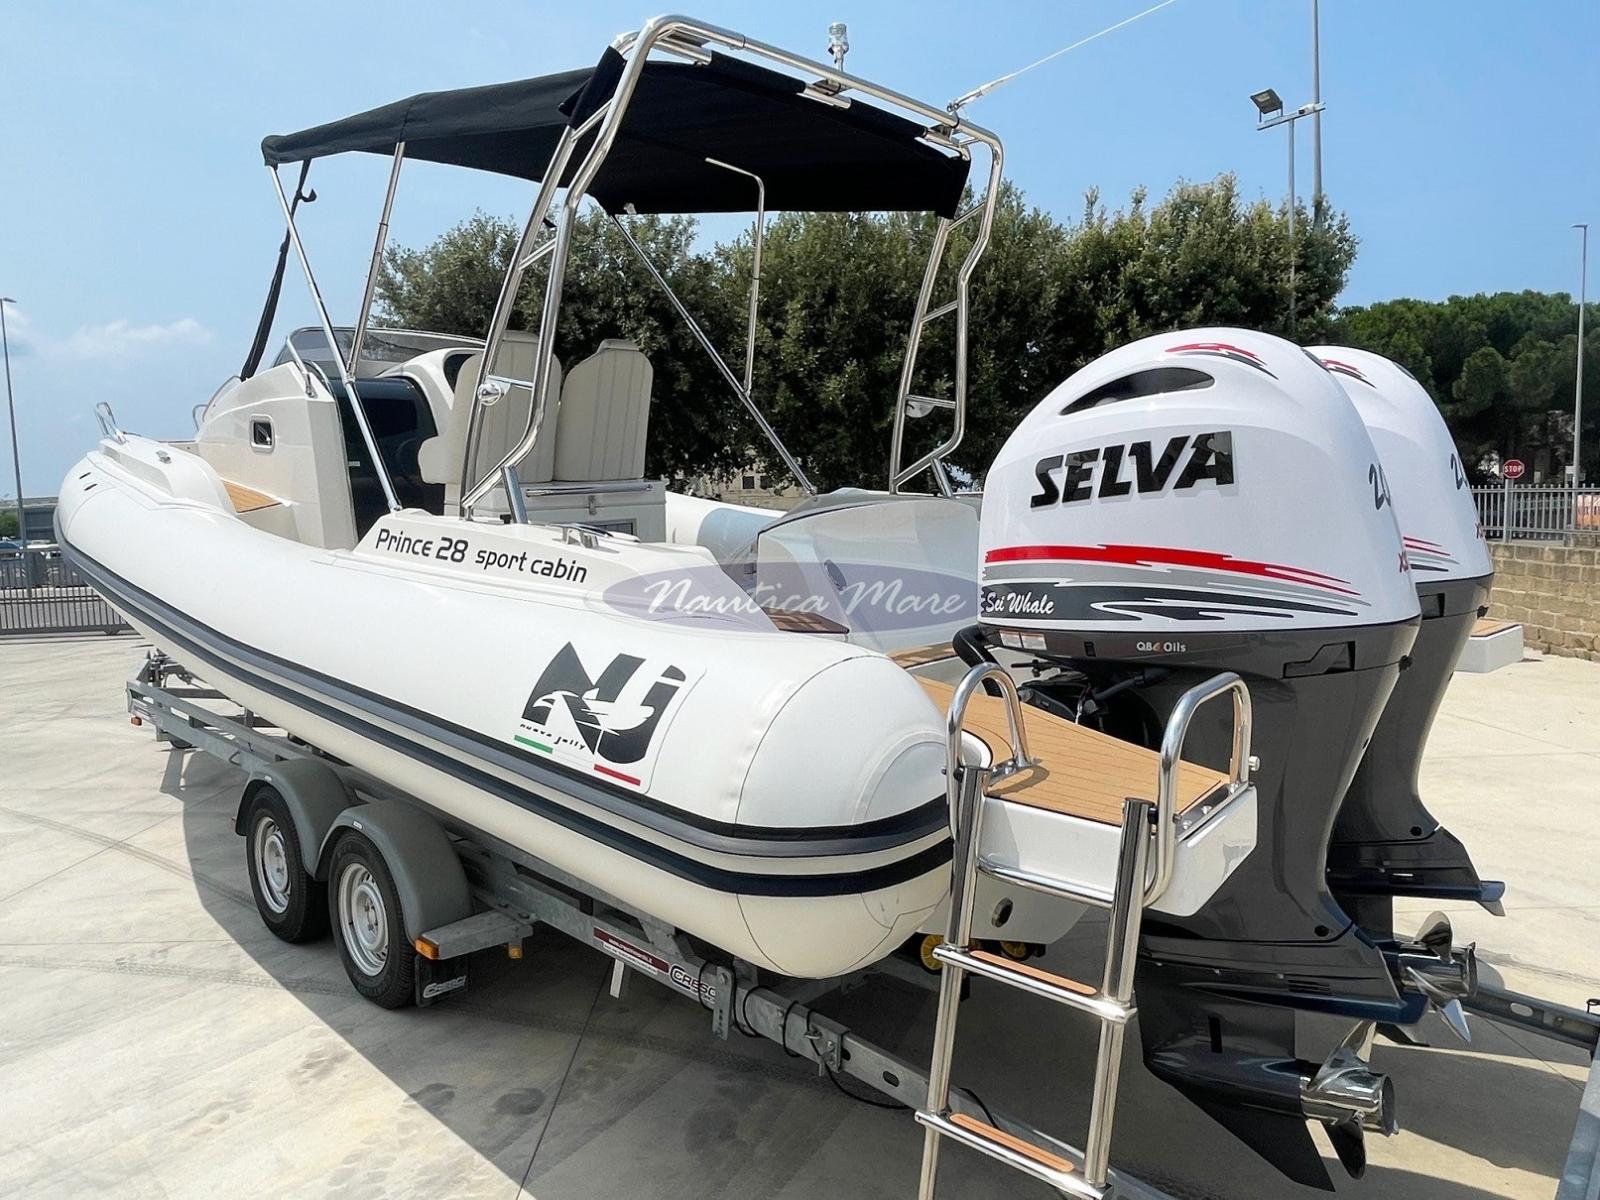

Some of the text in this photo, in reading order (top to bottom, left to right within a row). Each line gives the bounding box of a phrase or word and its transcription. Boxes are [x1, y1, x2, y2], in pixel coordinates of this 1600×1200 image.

[1030, 430, 1236, 509] SELVA
[1504, 465, 1522, 473] STOP
[375, 528, 588, 584] Prince 28 sport cabin
[1007, 591, 1055, 615] Whale
[1163, 642, 1187, 653] Oils
